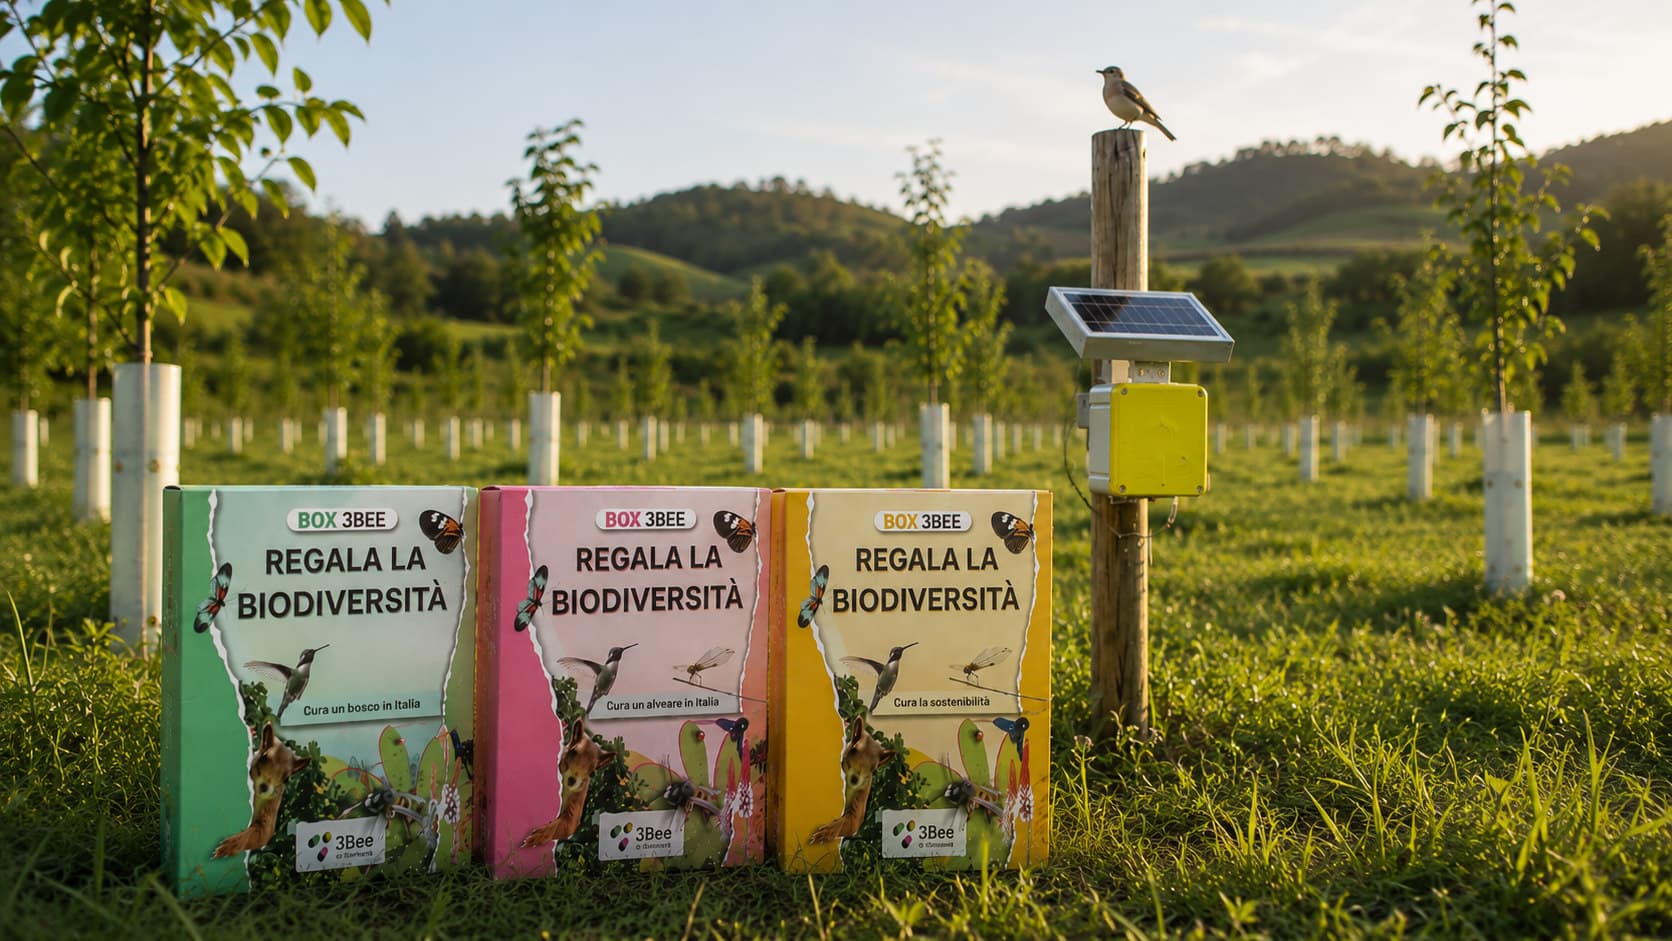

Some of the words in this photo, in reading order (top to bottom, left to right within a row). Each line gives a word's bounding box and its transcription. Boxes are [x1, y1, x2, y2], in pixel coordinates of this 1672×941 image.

[298, 511, 337, 529] BOX
[342, 511, 386, 528] 3BEE
[605, 511, 641, 528] BOX
[645, 511, 685, 527] 3BEE
[883, 513, 917, 529] BOX
[922, 513, 961, 529] 3BEE
[266, 547, 382, 575] REGALA
[391, 546, 426, 571] LA
[576, 545, 682, 572] REGALA
[690, 545, 722, 568] LA
[856, 547, 960, 571] REGALA
[967, 547, 999, 570] LA
[237, 579, 447, 619] BIODIVERSITÀ
[552, 577, 743, 615] BIODIVERSITÀ
[832, 579, 1020, 612] BIODIVERSITÀ
[304, 705, 329, 716] Cura
[332, 706, 345, 714] un
[348, 702, 380, 713] bosco
[383, 700, 392, 710] in
[395, 698, 420, 710] Italia
[607, 701, 629, 711] Cura
[632, 702, 644, 710] un
[647, 698, 682, 709] alveare
[685, 698, 693, 707] in
[696, 697, 719, 707] Italia
[894, 697, 917, 708] Cura
[919, 697, 928, 708] la
[636, 827, 672, 841] 3Bee
[919, 825, 954, 840] 3Bee
[336, 835, 374, 850] 3Bee
